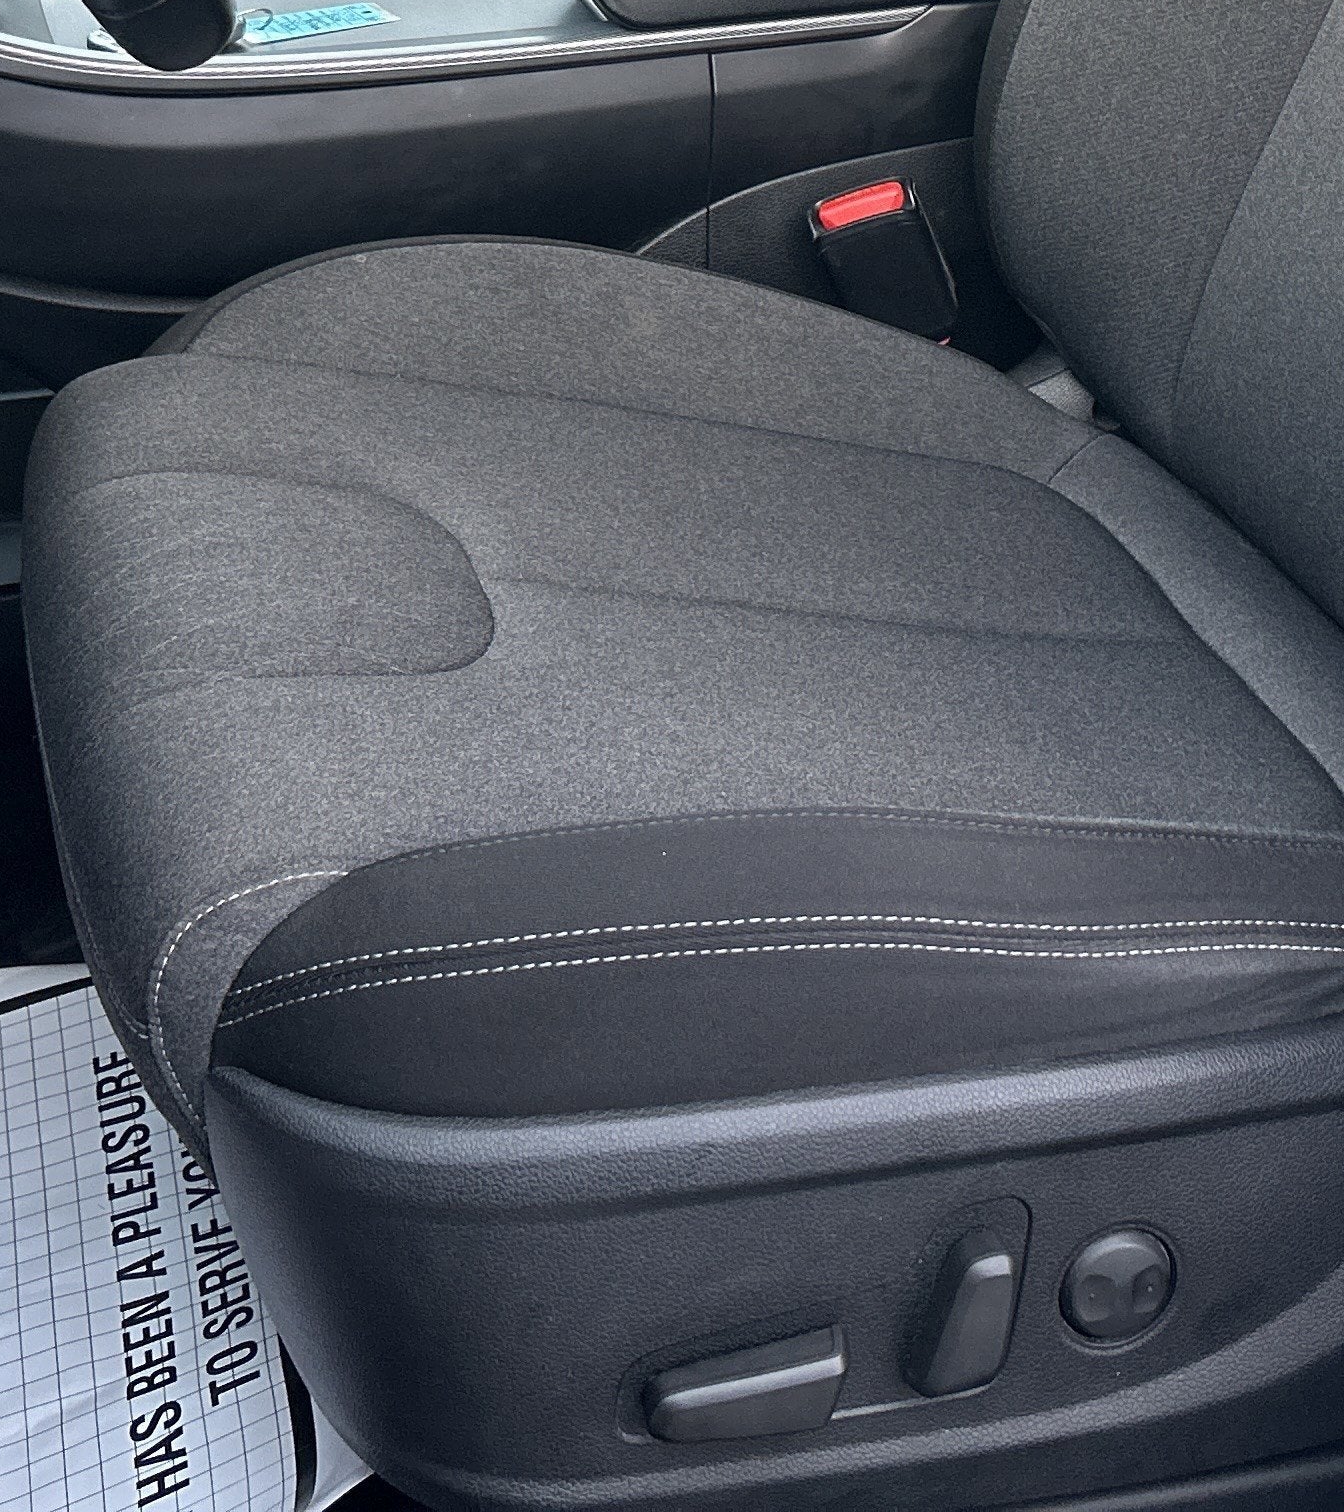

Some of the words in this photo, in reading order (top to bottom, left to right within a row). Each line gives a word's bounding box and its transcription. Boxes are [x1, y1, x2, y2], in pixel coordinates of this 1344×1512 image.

[92, 1052, 162, 1247] PLEASURE
[178, 1140, 221, 1211] YO
[116, 1249, 168, 1282] A
[191, 1218, 254, 1339] SERVE
[119, 1290, 177, 1401] BEEN
[206, 1340, 261, 1407] TO
[129, 1400, 190, 1508] HAS
